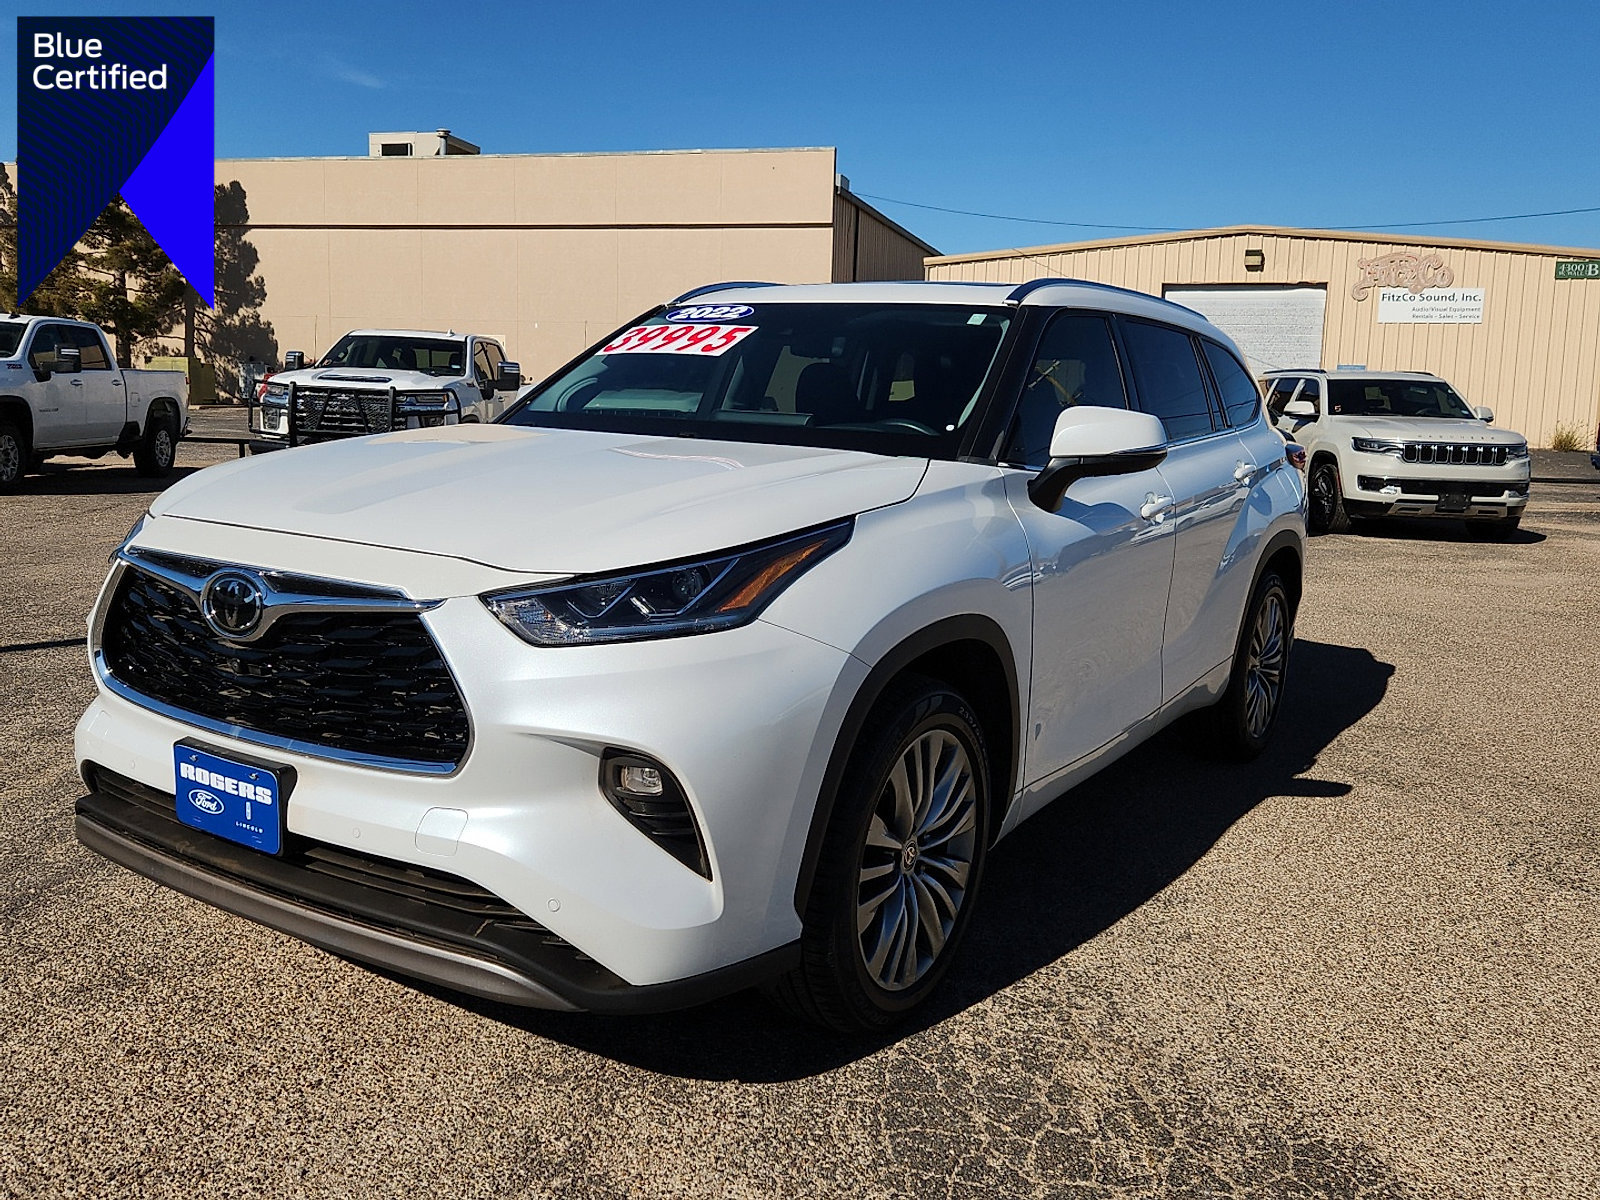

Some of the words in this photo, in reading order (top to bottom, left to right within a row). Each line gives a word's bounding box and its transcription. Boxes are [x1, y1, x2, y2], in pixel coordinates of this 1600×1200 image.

[1559, 263, 1585, 271] 4300
[1587, 263, 1599, 276] B
[1381, 293, 1416, 302] FitzCo
[1419, 292, 1458, 303] Sound,
[1461, 292, 1482, 302] Inc.
[673, 306, 748, 319] 2022
[603, 326, 752, 352] 39995
[180, 762, 272, 805] ROGERS
[195, 792, 217, 812] Ford
[235, 820, 264, 834] LINCOLN
